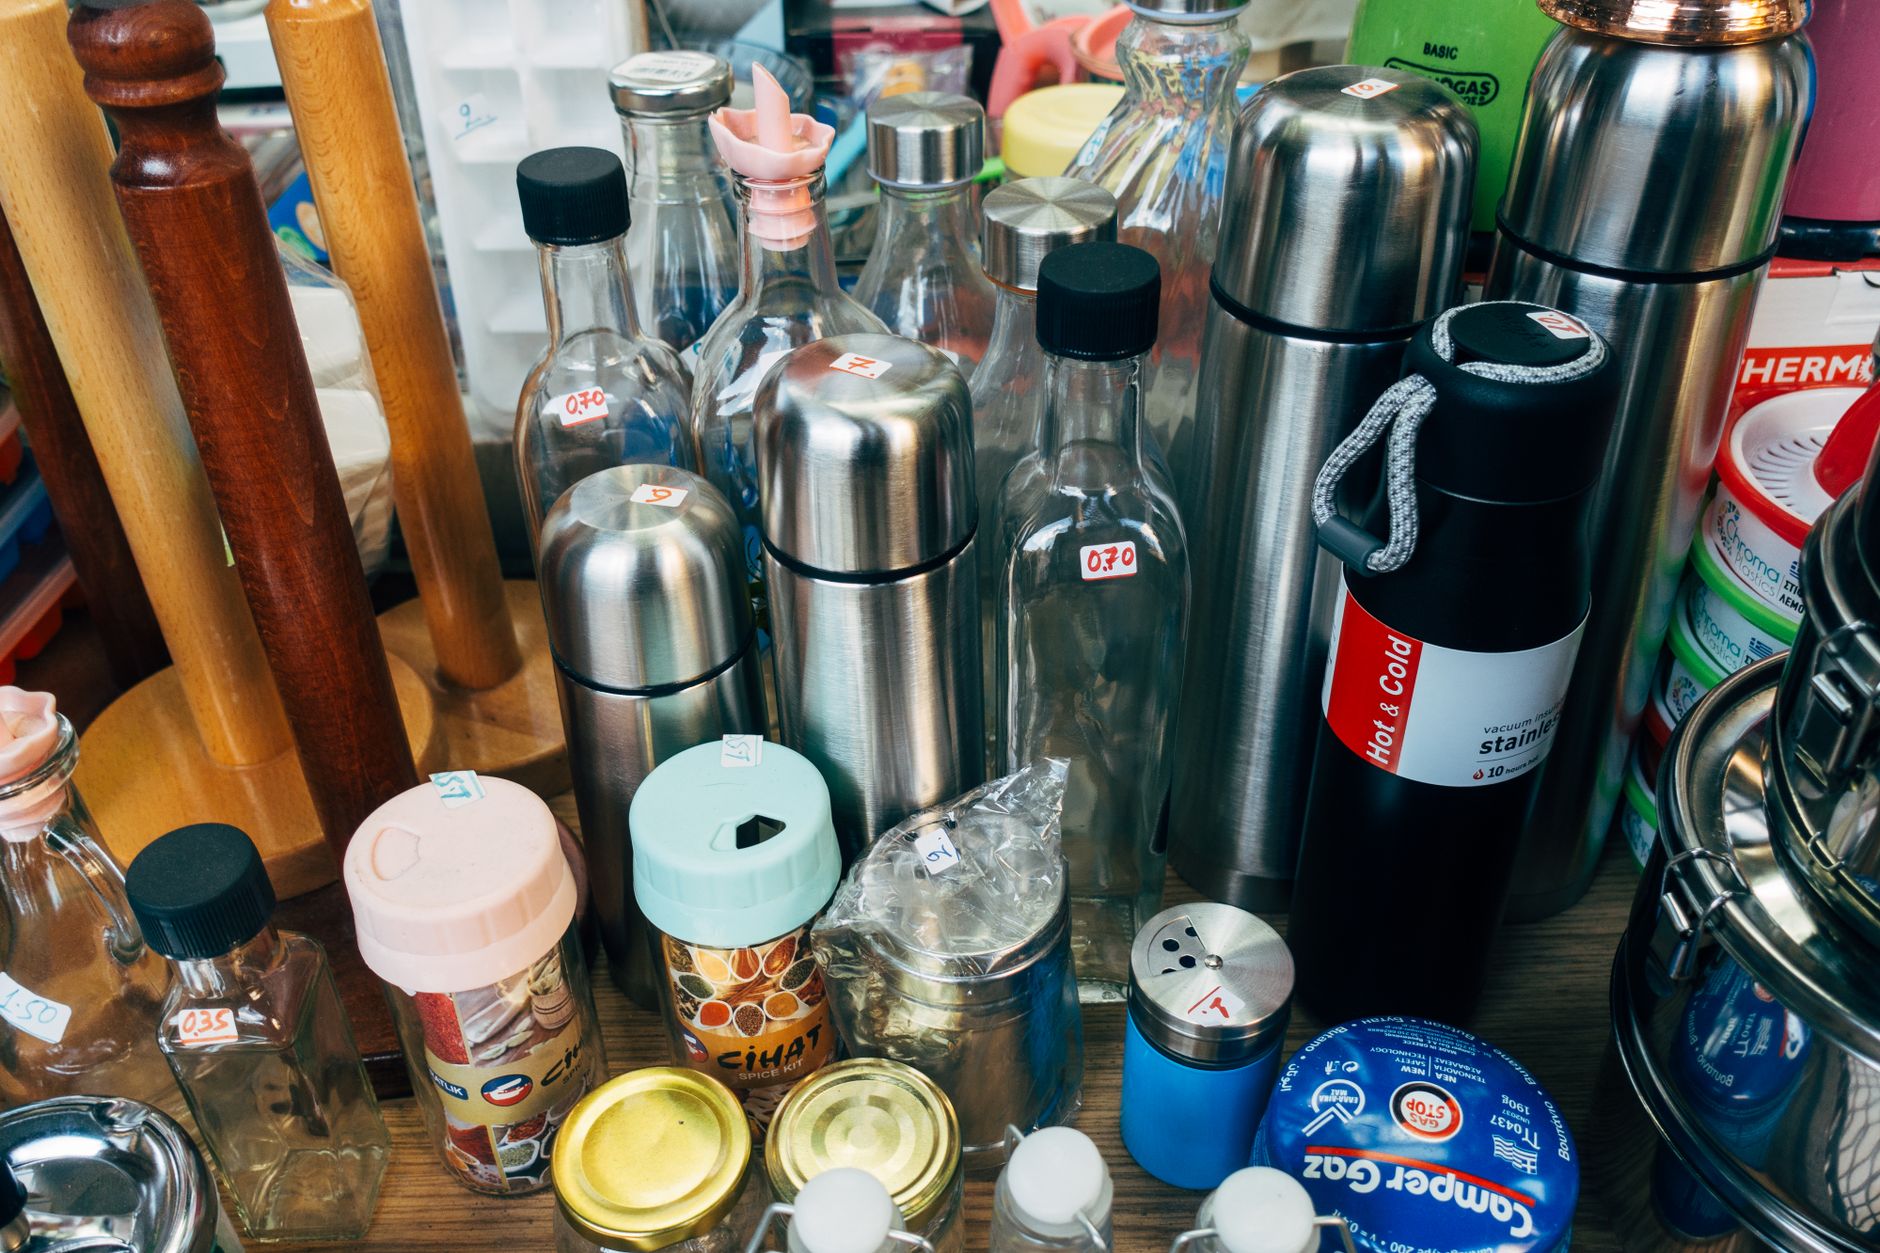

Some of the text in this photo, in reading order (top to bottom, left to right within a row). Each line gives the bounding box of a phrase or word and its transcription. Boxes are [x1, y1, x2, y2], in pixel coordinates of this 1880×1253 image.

[1423, 42, 1458, 60] BASIC
[1727, 518, 1780, 583] Chroma
[1735, 552, 1775, 597] Plastics
[1366, 634, 1412, 764] Hot & Cold
[1484, 718, 1532, 734] vacuum
[1487, 765, 1504, 778] 10
[1505, 762, 1527, 774] hours
[1305, 1026, 1348, 1052] Butano
[1370, 1047, 1426, 1060] TECHNOLOGY
[1439, 1047, 1457, 1056] MADE
[739, 1058, 803, 1081] SPICE KIT
[1395, 1058, 1426, 1068] SAFETY
[1401, 1065, 1426, 1077] NEW
[1493, 1048, 1536, 1086] Butane
[1405, 1098, 1446, 1119] STOP
[1501, 1094, 1531, 1115] 190g
[1409, 1114, 1440, 1129] GAS
[1502, 1109, 1530, 1125] UN2037
[1302, 1155, 1534, 1238] Camper Gaz
[1390, 1241, 1414, 1253] 200
